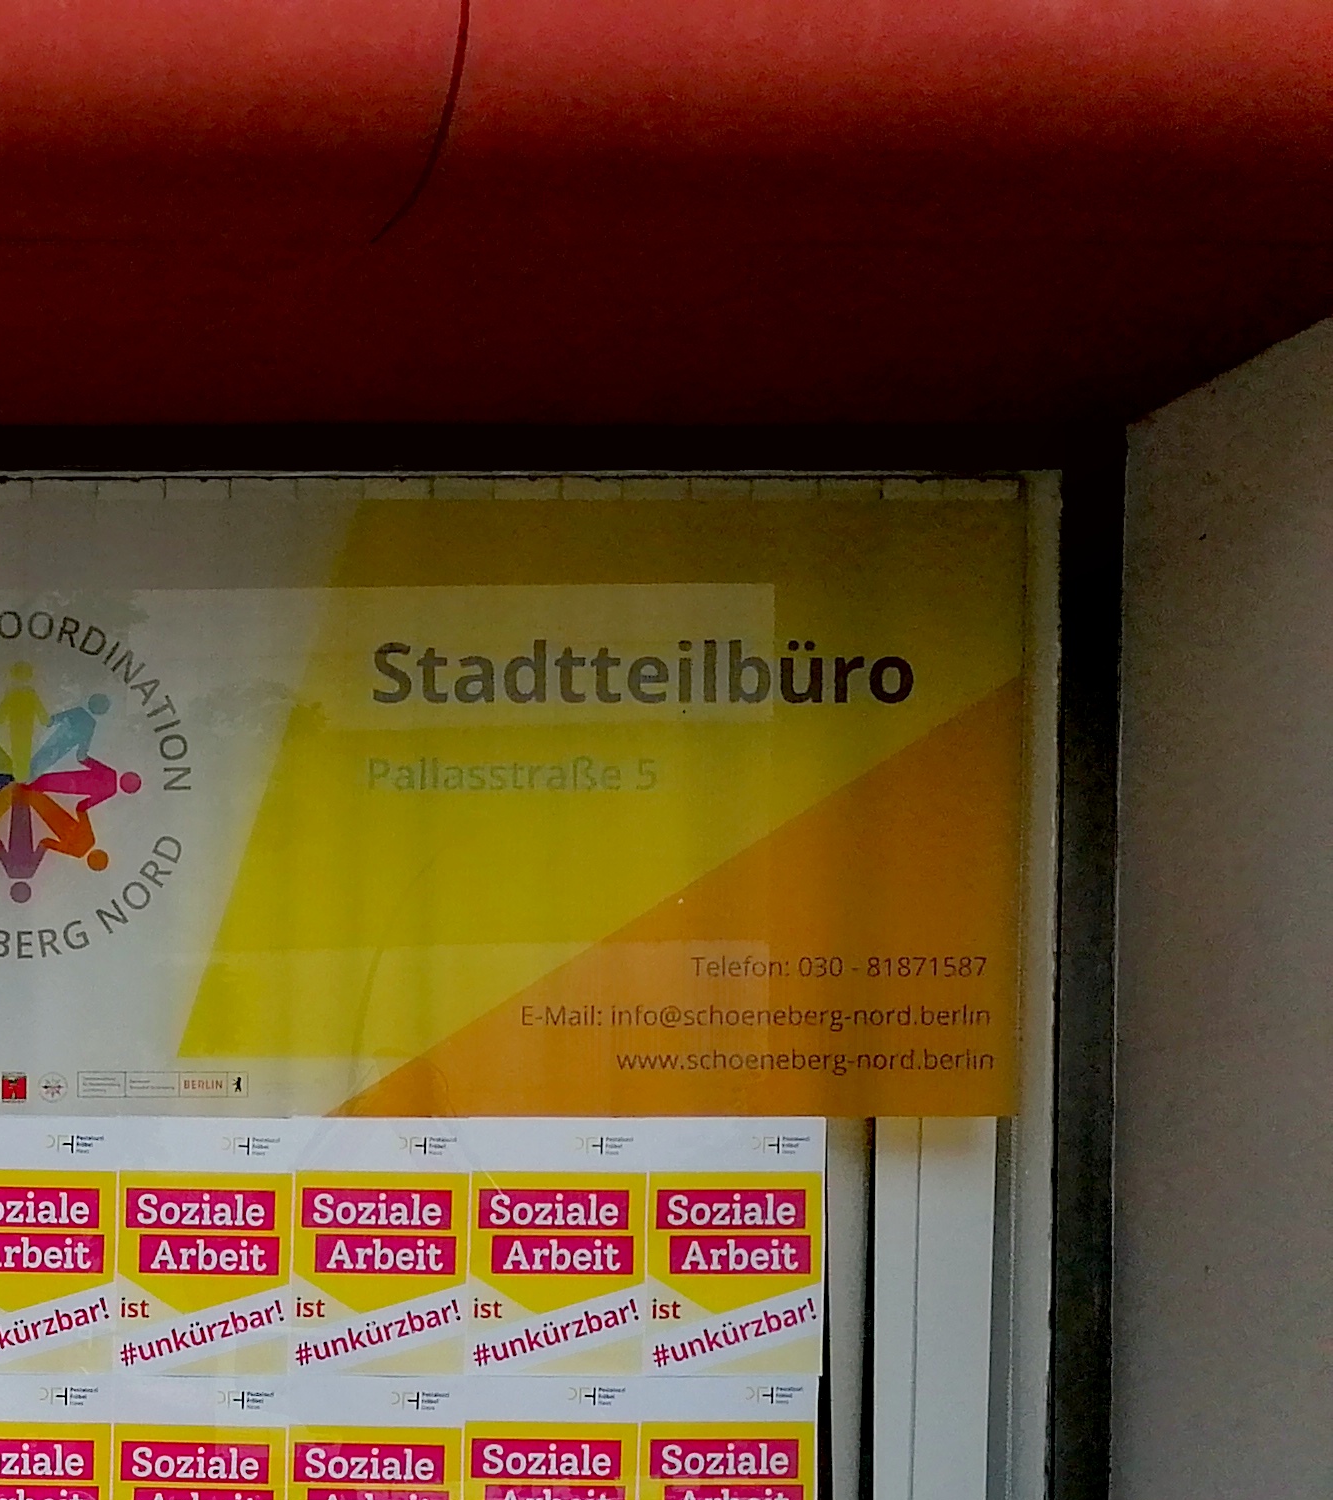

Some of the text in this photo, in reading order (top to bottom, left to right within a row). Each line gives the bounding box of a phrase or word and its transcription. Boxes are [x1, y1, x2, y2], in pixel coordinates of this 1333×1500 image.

[372, 639, 915, 704] Stadtteilbüro
[367, 756, 658, 792] Pallasstraße 5
[97, 833, 183, 935] NORD
[690, 956, 790, 978] Telefon:
[798, 956, 845, 978] 030
[867, 956, 987, 978] 81871587
[520, 1004, 991, 1033] E-Mail: info@schoeneberg-nord.berlin
[616, 1048, 995, 1076] www.schoeneberg-nord.berlin
[183, 1079, 223, 1090] BERLIN
[137, 1193, 265, 1227] Soziale
[313, 1193, 442, 1226] Soziale
[489, 1193, 619, 1226] Soziale
[667, 1193, 796, 1226] Soziale
[150, 1239, 267, 1272] Arbeit
[326, 1238, 444, 1271] Arbeit
[502, 1239, 621, 1271] Arbeit
[681, 1239, 799, 1271] Arbeit
[120, 1296, 150, 1319] ist
[296, 1296, 326, 1318] ist
[473, 1297, 503, 1319] ist
[652, 1297, 682, 1320] ist
[119, 1299, 285, 1367] #unkürzbar!
[295, 1298, 461, 1367] #unkürzbar!
[472, 1298, 640, 1367] #unkürzbar!
[651, 1297, 817, 1368] #unkürzbar!
[131, 1446, 259, 1480] Soziale
[305, 1447, 435, 1481] Soziale
[482, 1443, 611, 1476] Soziale
[661, 1443, 789, 1475] Soziale
